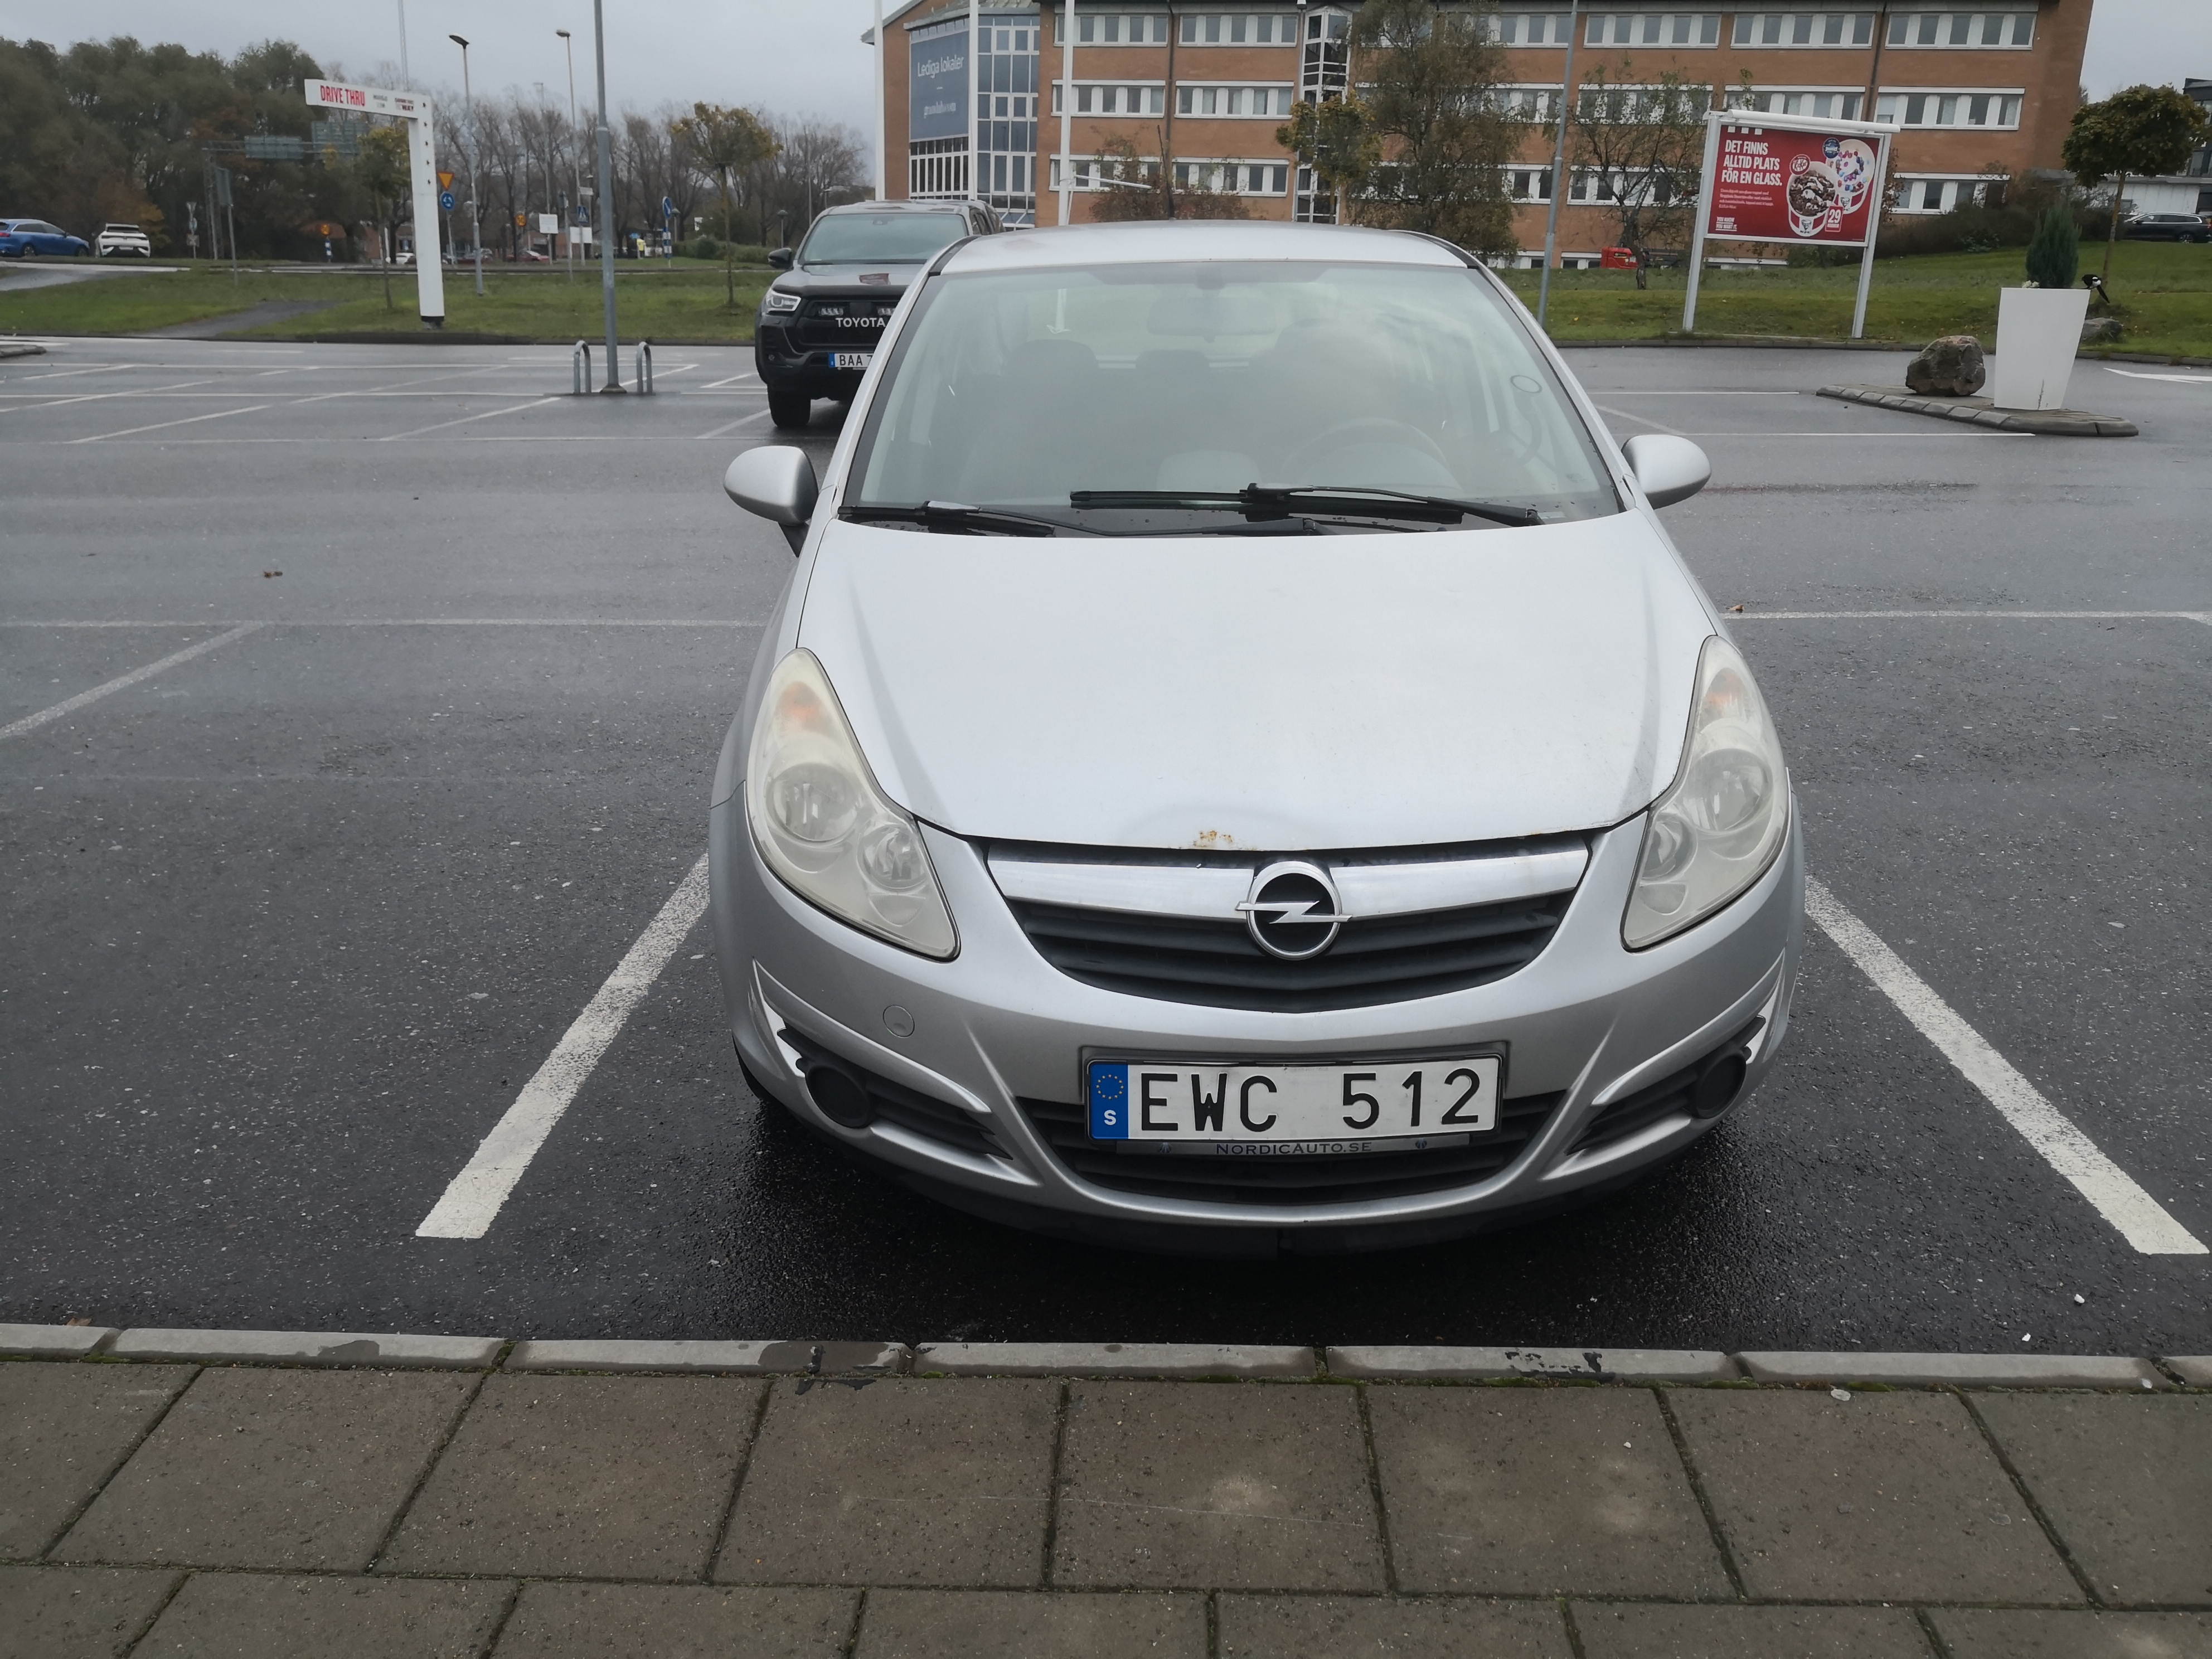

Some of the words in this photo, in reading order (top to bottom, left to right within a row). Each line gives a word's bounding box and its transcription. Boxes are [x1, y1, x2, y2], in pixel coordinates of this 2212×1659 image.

[918, 60, 939, 79] Lediga
[940, 54, 964, 72] lokaler
[320, 85, 343, 104] DRIVE
[345, 89, 366, 107] THRU
[1725, 139, 1743, 153] DET
[1743, 141, 1768, 155] FINNS
[1723, 154, 1752, 169] ALLTID
[1753, 157, 1780, 171] PLATS
[1721, 167, 1739, 183] FÖR
[1740, 171, 1752, 184] EN
[1753, 172, 1783, 186] GLASS.
[1828, 209, 1842, 224] 29
[836, 317, 886, 328] TOYOTA
[839, 355, 863, 366] BAA
[1104, 1109, 1117, 1126] S
[1141, 1073, 1278, 1133] EWC
[1342, 1068, 1481, 1129] 512
[1216, 1142, 1372, 1155] NORDICAUTO.SE
